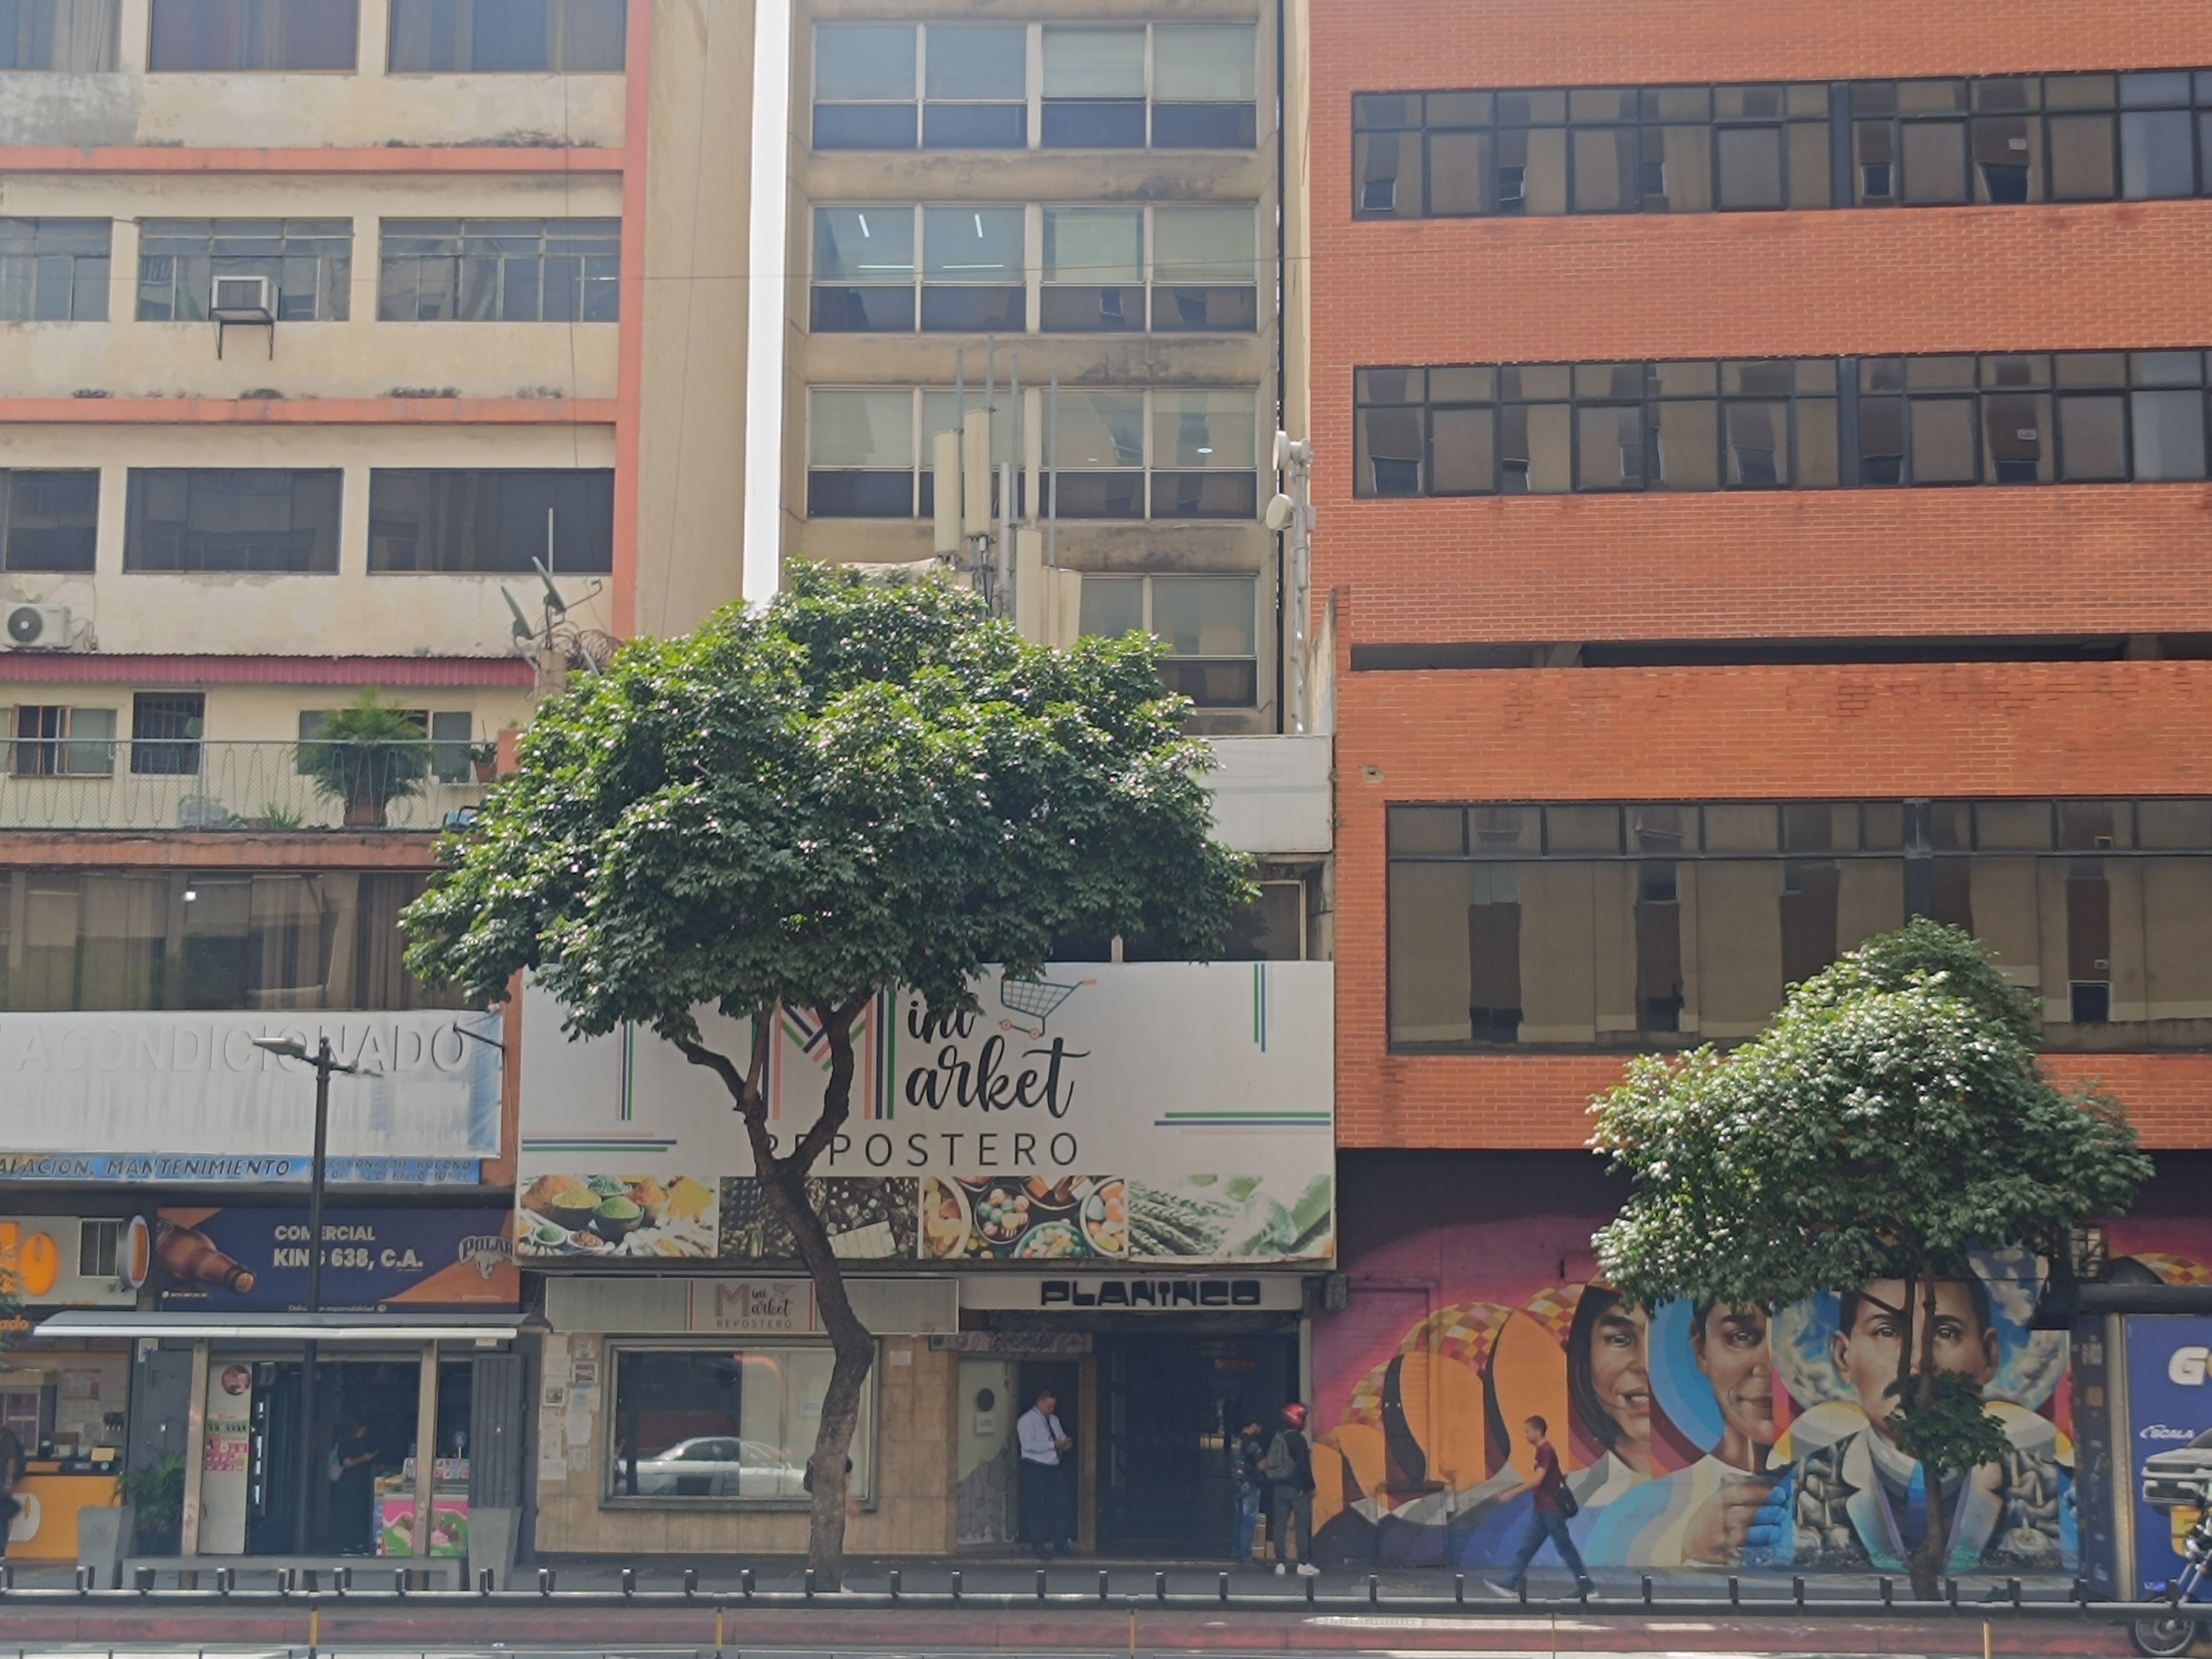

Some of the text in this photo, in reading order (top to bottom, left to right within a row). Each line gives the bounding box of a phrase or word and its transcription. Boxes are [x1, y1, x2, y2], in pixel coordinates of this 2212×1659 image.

[107, 1159, 291, 1175] MANTENIMIENTO
[274, 1247, 424, 1271] KIN 638, C.A.
[716, 1319, 792, 1328] REPOSTERO
